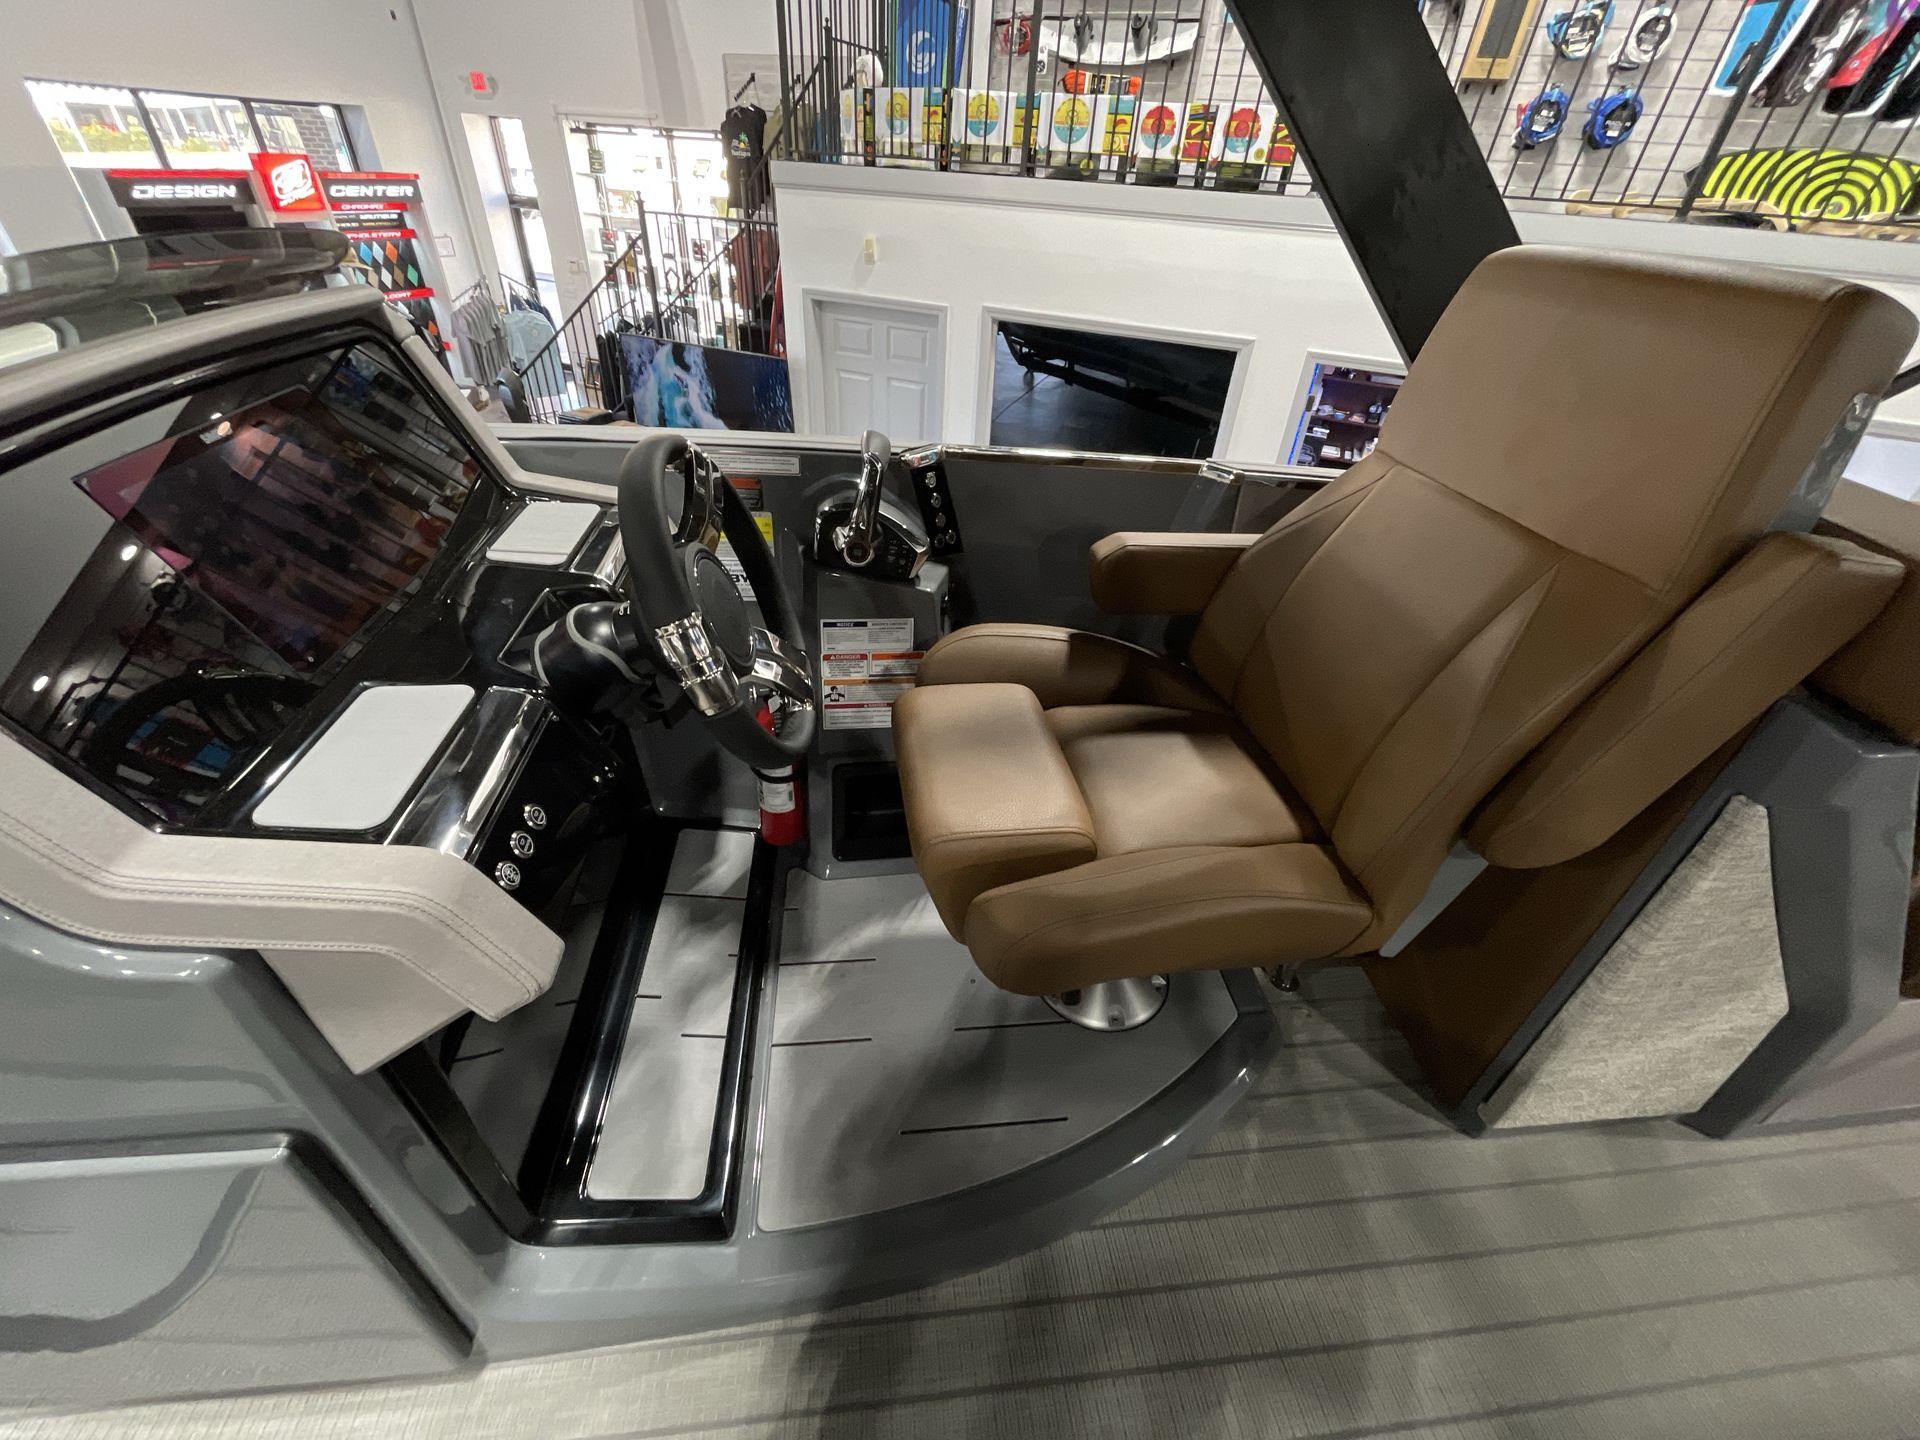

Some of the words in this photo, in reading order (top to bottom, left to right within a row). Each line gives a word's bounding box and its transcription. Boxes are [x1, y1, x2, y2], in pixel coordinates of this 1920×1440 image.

[131, 184, 237, 199] DESIGN
[329, 185, 414, 197] CENTER
[346, 231, 401, 239] PHOLSTERY
